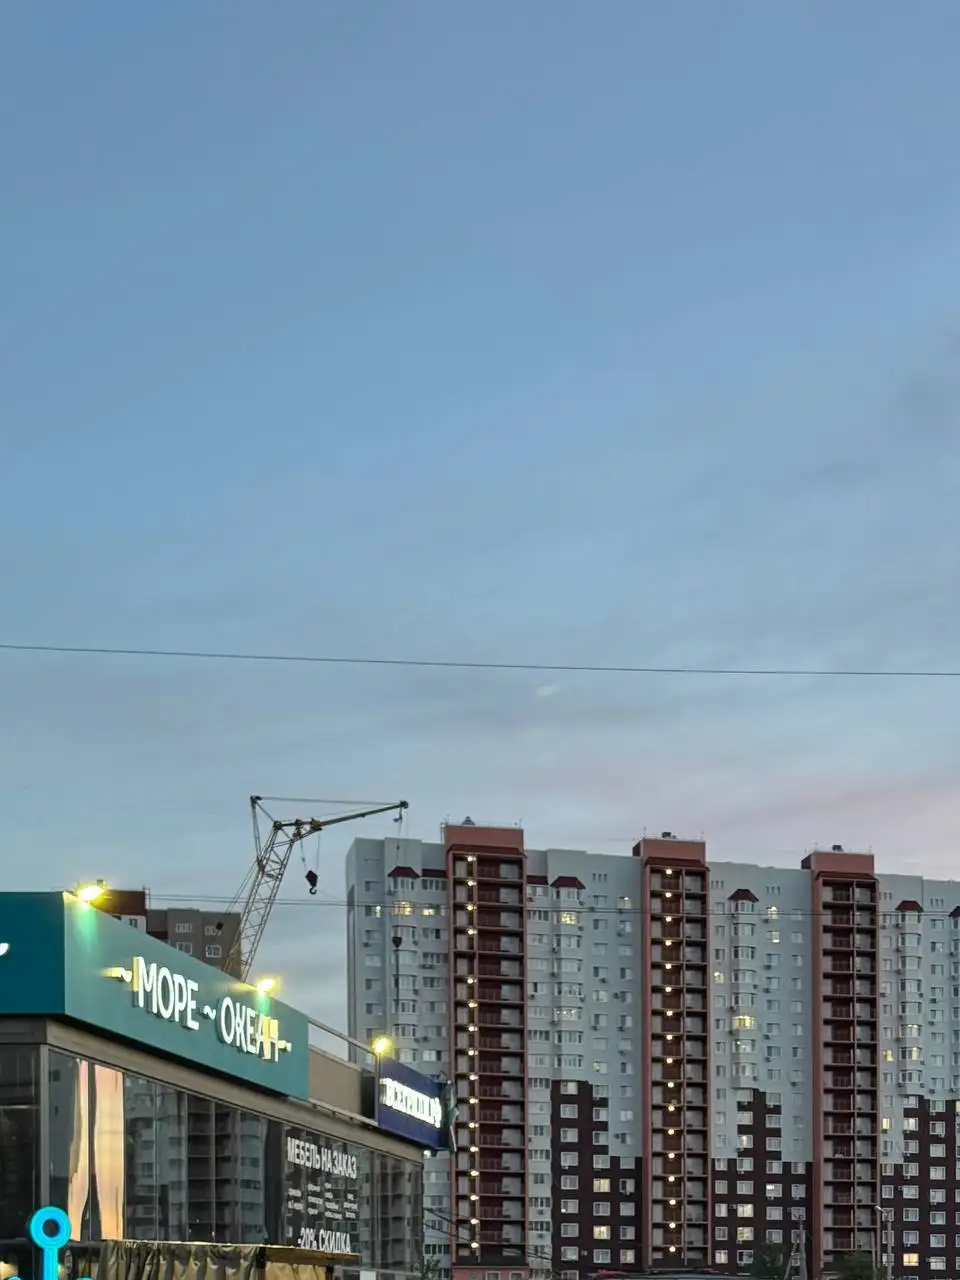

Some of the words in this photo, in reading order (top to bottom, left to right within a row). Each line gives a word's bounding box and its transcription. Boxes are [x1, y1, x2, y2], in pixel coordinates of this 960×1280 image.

[132, 956, 200, 1031] МОРЕ
[219, 996, 279, 1063] ОКЕАН
[287, 1136, 321, 1170] МЕБЕЛЬ
[321, 1147, 333, 1173] НА
[333, 1150, 357, 1180] ЗАКАЗ
[319, 1228, 351, 1255] СКИДКА
